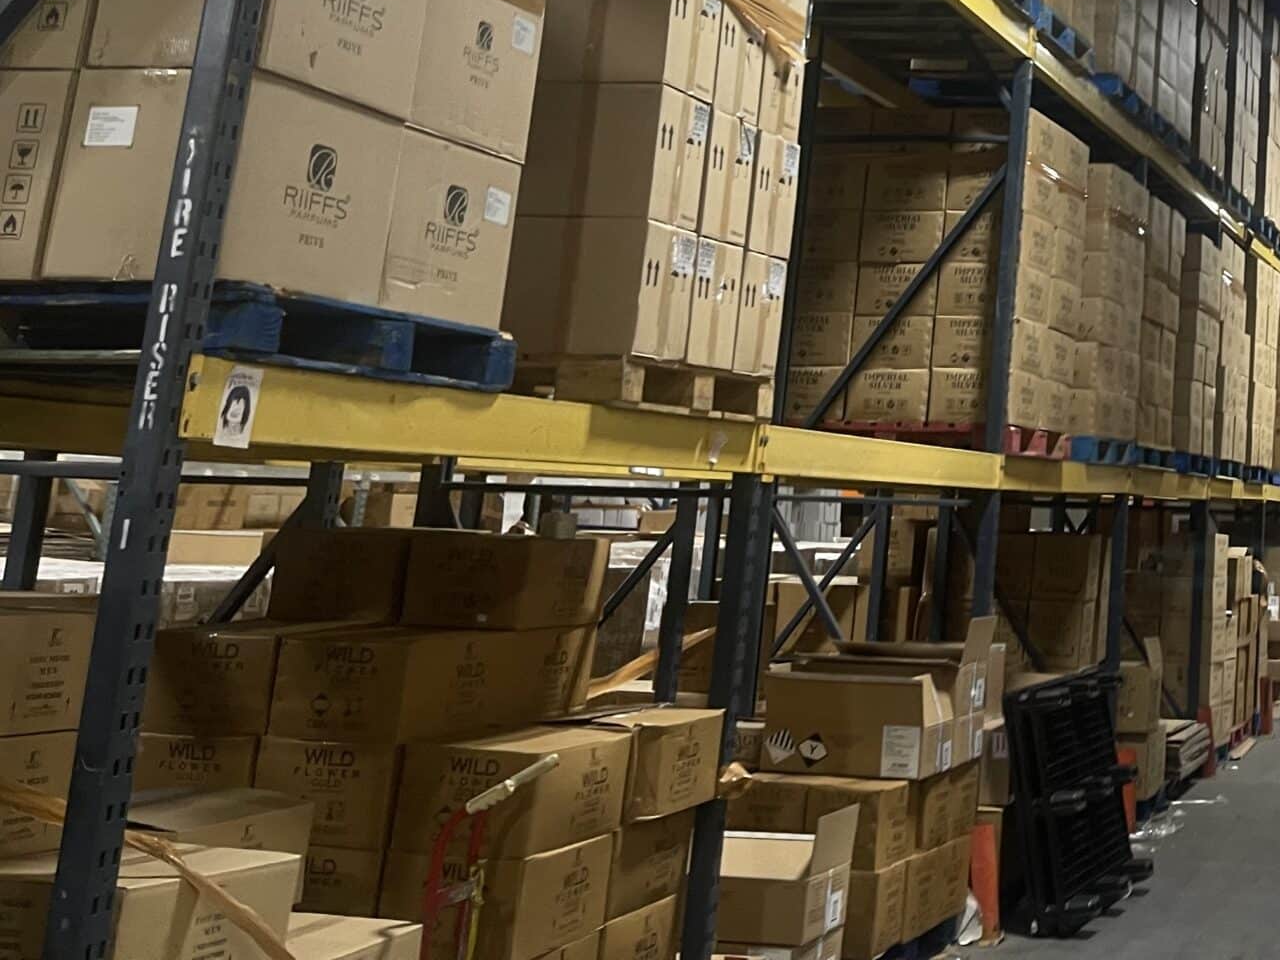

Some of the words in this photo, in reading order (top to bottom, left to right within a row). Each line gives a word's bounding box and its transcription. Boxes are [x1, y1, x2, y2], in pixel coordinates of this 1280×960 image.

[463, 46, 501, 73] RIIFFS
[283, 184, 350, 221] RIIFFS
[424, 221, 480, 253] RIIFFS
[138, 282, 179, 431] RISER
[326, 646, 376, 665] WILD
[168, 741, 217, 761] WILD
[304, 746, 355, 767] WILD
[808, 743, 819, 755] Y
[158, 759, 222, 773] FLOWER
[293, 765, 361, 779] FLOWER
[450, 756, 501, 777] WILD
[582, 767, 609, 787] WILD
